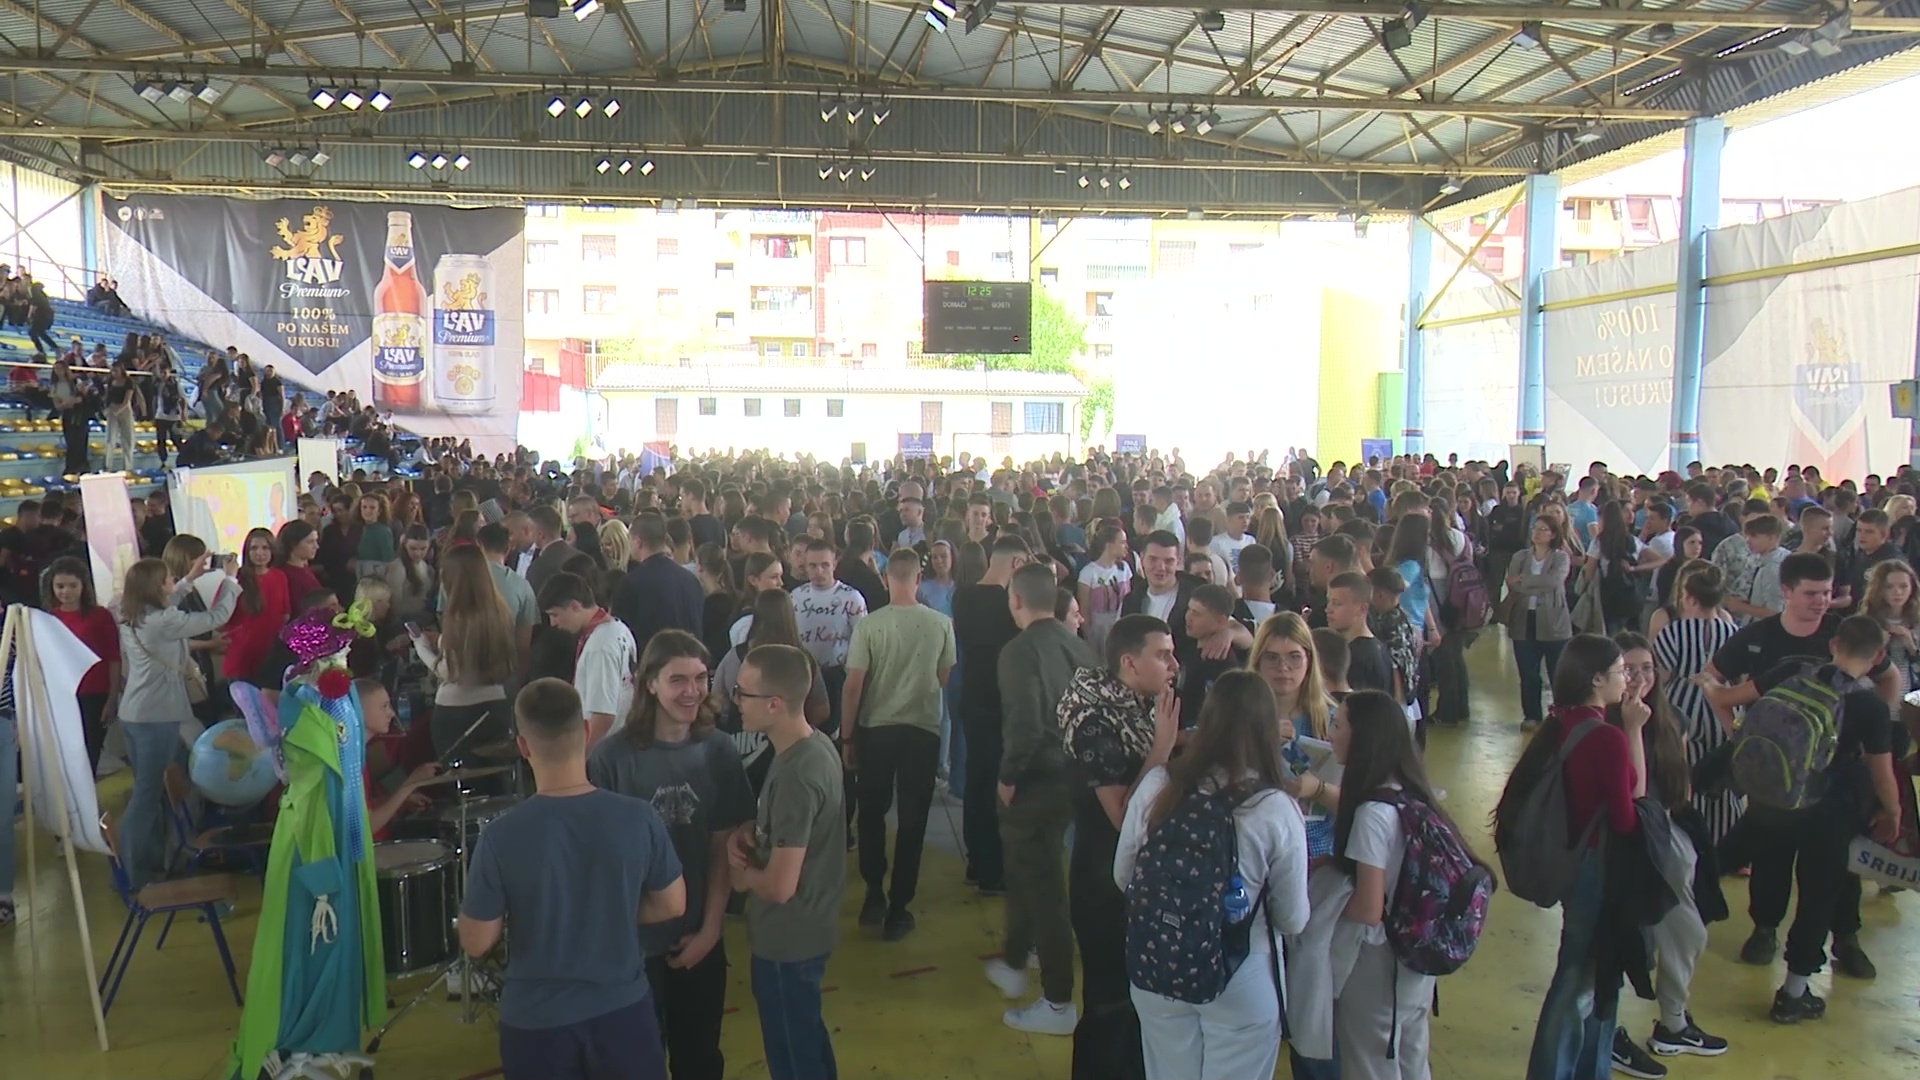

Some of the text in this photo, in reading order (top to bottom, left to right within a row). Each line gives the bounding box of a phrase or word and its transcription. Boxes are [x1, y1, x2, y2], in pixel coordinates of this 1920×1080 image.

[286, 257, 344, 285] LAV
[279, 282, 350, 299] Premium
[292, 307, 336, 320] 100%
[277, 321, 349, 335] PO NAŠEM
[443, 311, 485, 333] LAV
[287, 336, 340, 348] UKUSU!
[438, 330, 489, 343] Premium
[384, 348, 415, 363] LAV
[801, 597, 839, 618] Sport
[1857, 850, 1920, 883] SRBIJ
